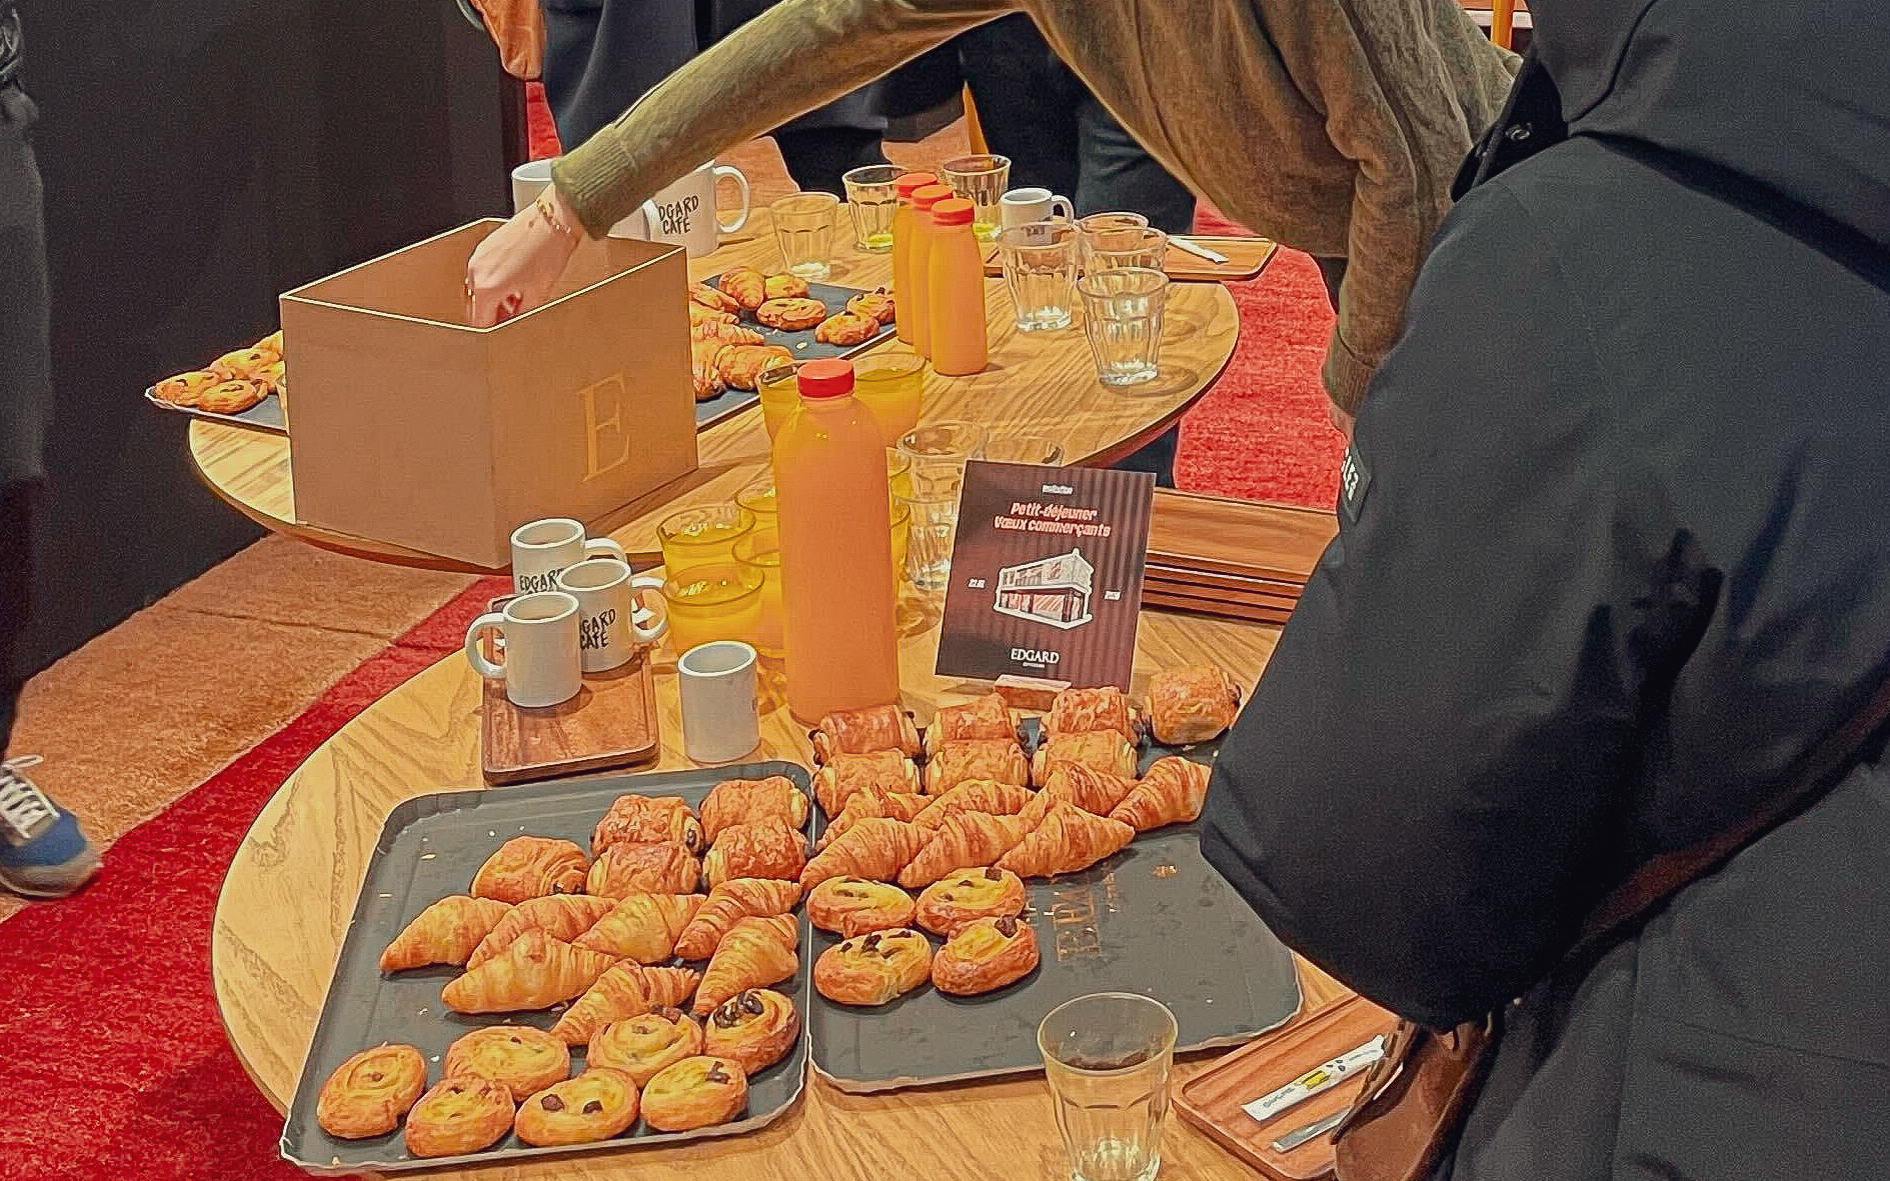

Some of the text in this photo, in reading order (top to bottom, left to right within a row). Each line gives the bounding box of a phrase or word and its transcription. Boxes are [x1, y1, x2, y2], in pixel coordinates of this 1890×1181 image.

[658, 195, 699, 221] DGARD
[574, 372, 630, 482] E
[1010, 502, 1098, 521] Petit-déjeuner
[1028, 520, 1112, 538] commerçants
[1010, 648, 1060, 664] EDGARD
